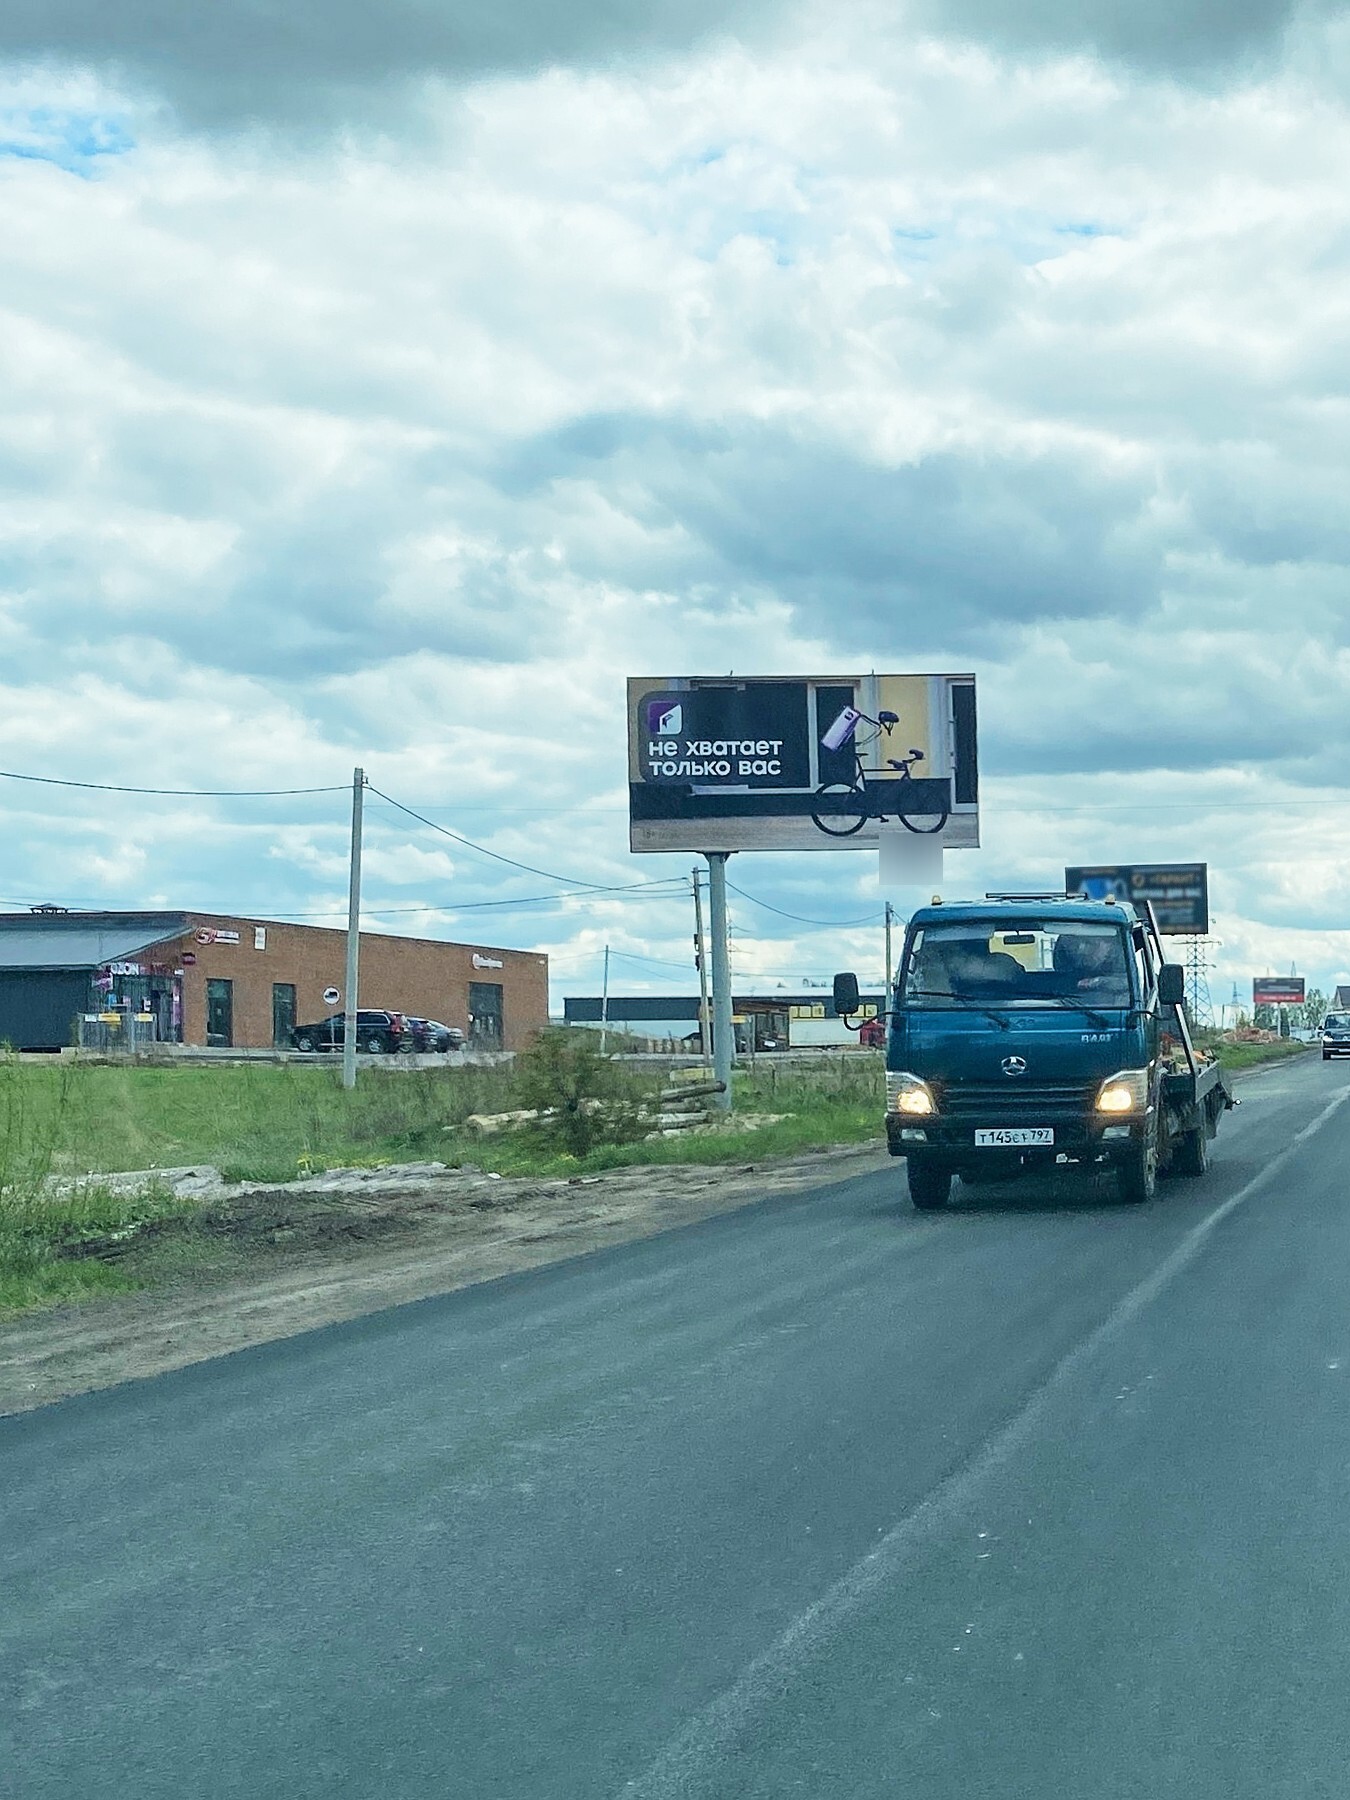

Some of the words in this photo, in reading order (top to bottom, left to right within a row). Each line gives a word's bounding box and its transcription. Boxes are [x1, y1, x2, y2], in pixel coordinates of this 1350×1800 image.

[648, 740, 678, 757] не
[685, 740, 783, 756] хватает
[648, 760, 731, 776] только
[738, 760, 781, 775] вас
